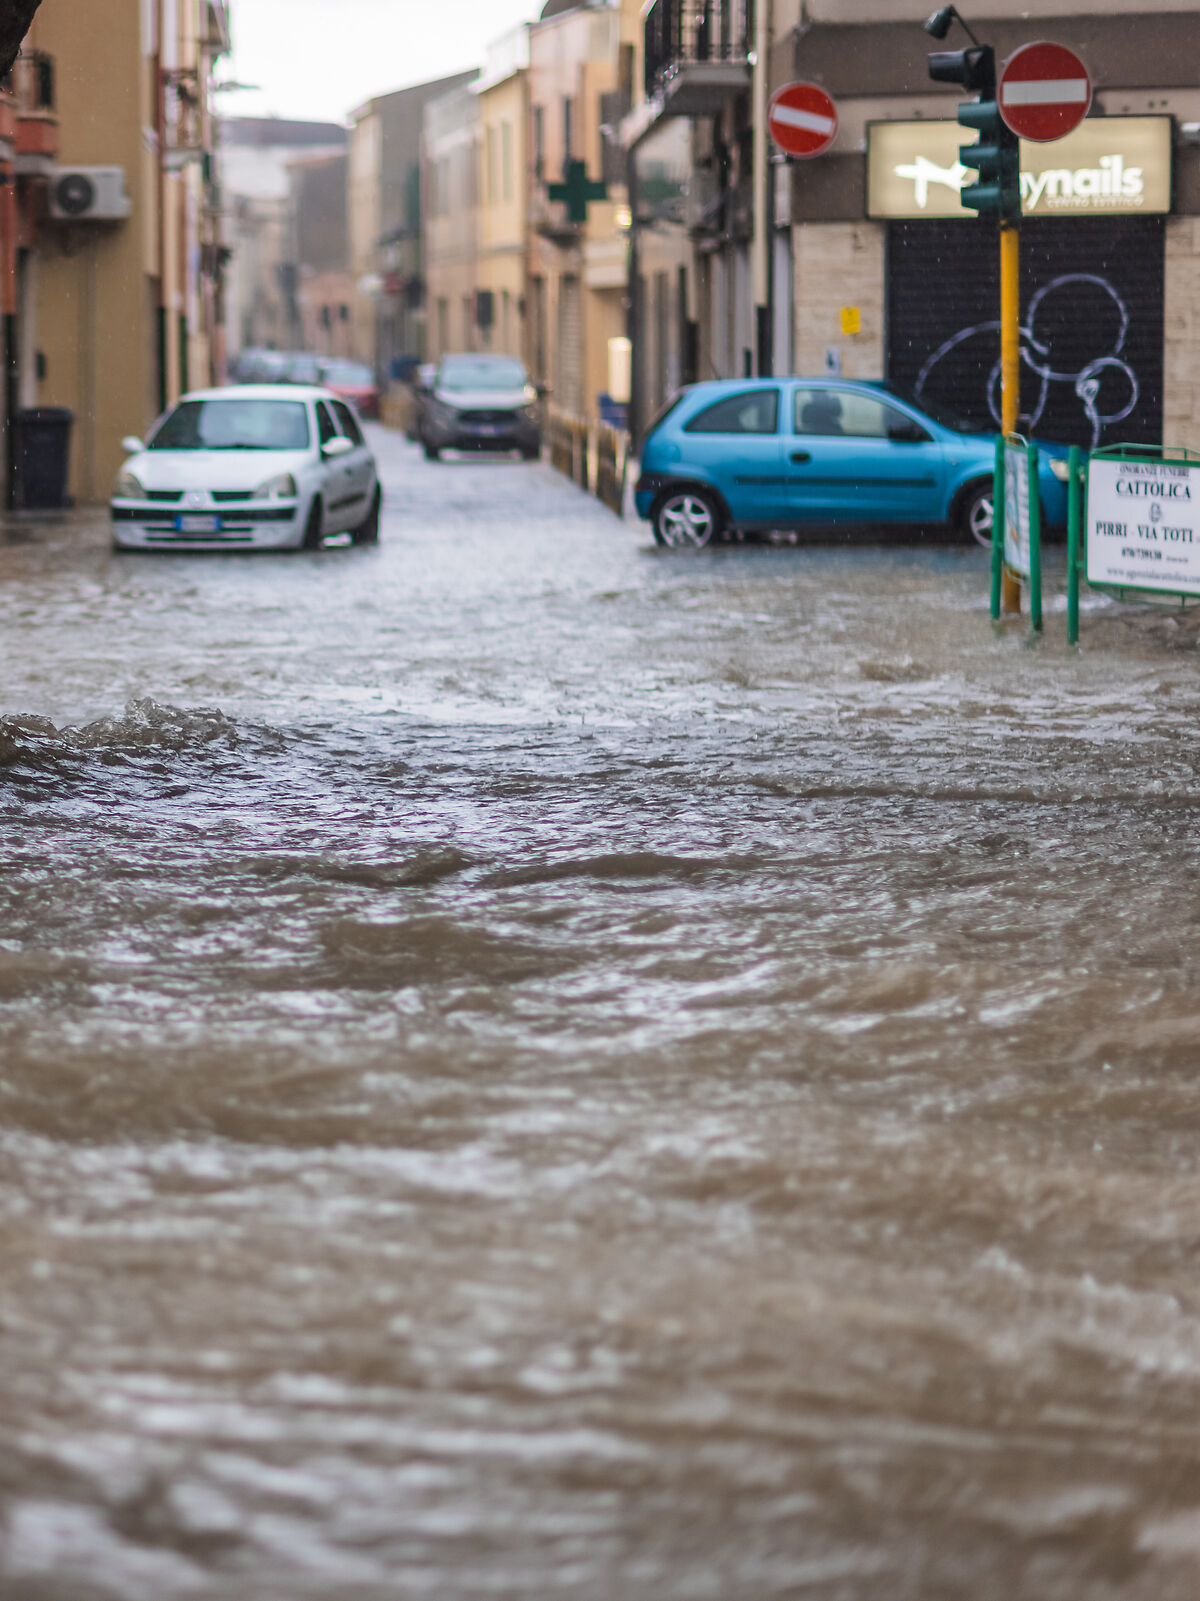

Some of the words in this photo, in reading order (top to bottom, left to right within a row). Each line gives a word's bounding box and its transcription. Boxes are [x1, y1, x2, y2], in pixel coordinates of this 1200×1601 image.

[1116, 480, 1191, 499] CATTOLICA
[1096, 521, 1127, 537] PIRRI
[1137, 524, 1157, 540] VIA
[1161, 527, 1193, 542] TOTI
